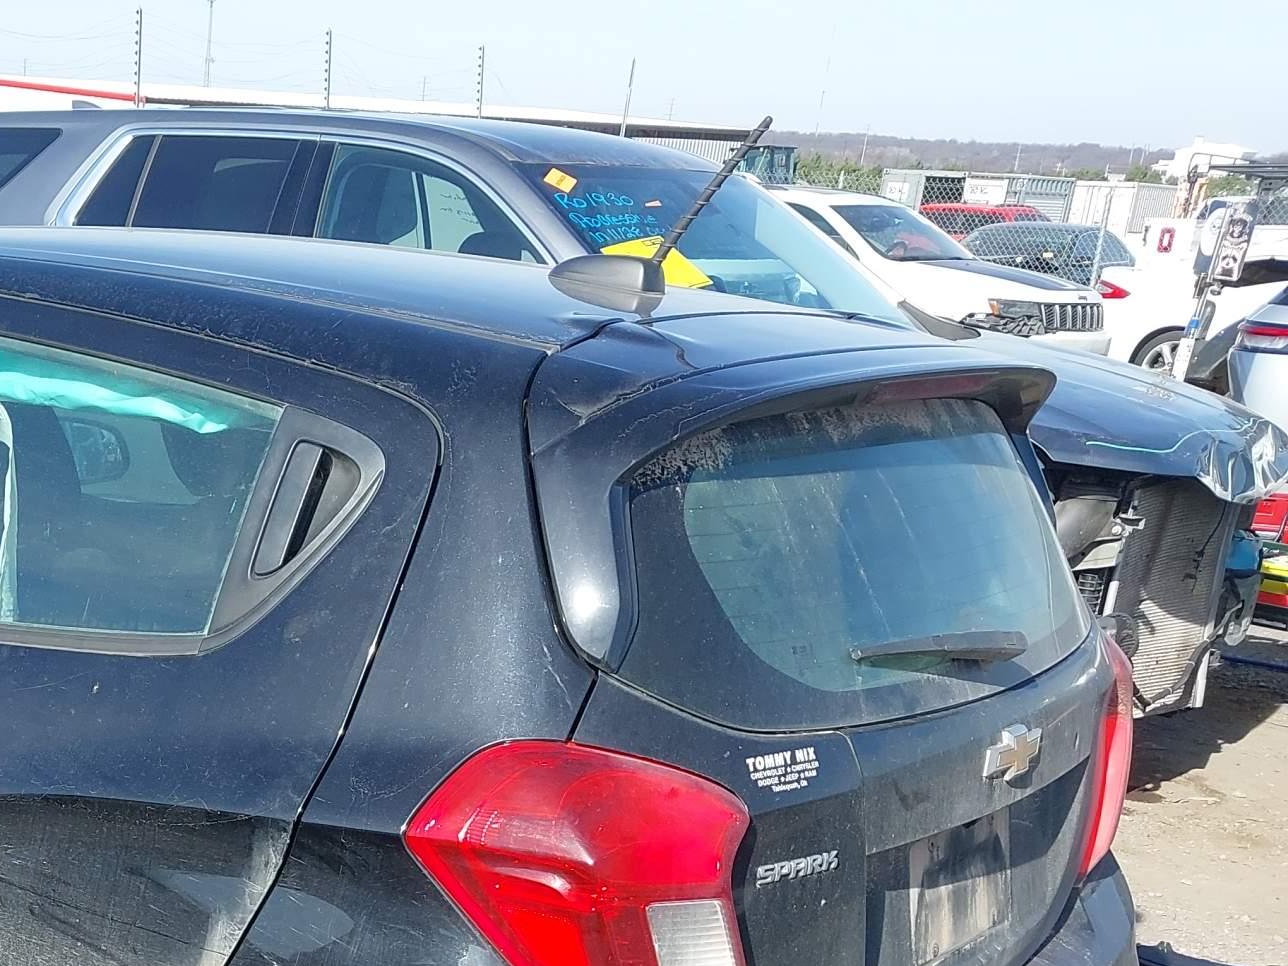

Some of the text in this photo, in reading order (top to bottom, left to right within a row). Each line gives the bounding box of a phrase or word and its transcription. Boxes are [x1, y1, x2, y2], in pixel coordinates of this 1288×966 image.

[745, 746, 817, 772] TOMMY NIX
[750, 766, 786, 781] CHEVROLET
[755, 850, 839, 889] SPARK
